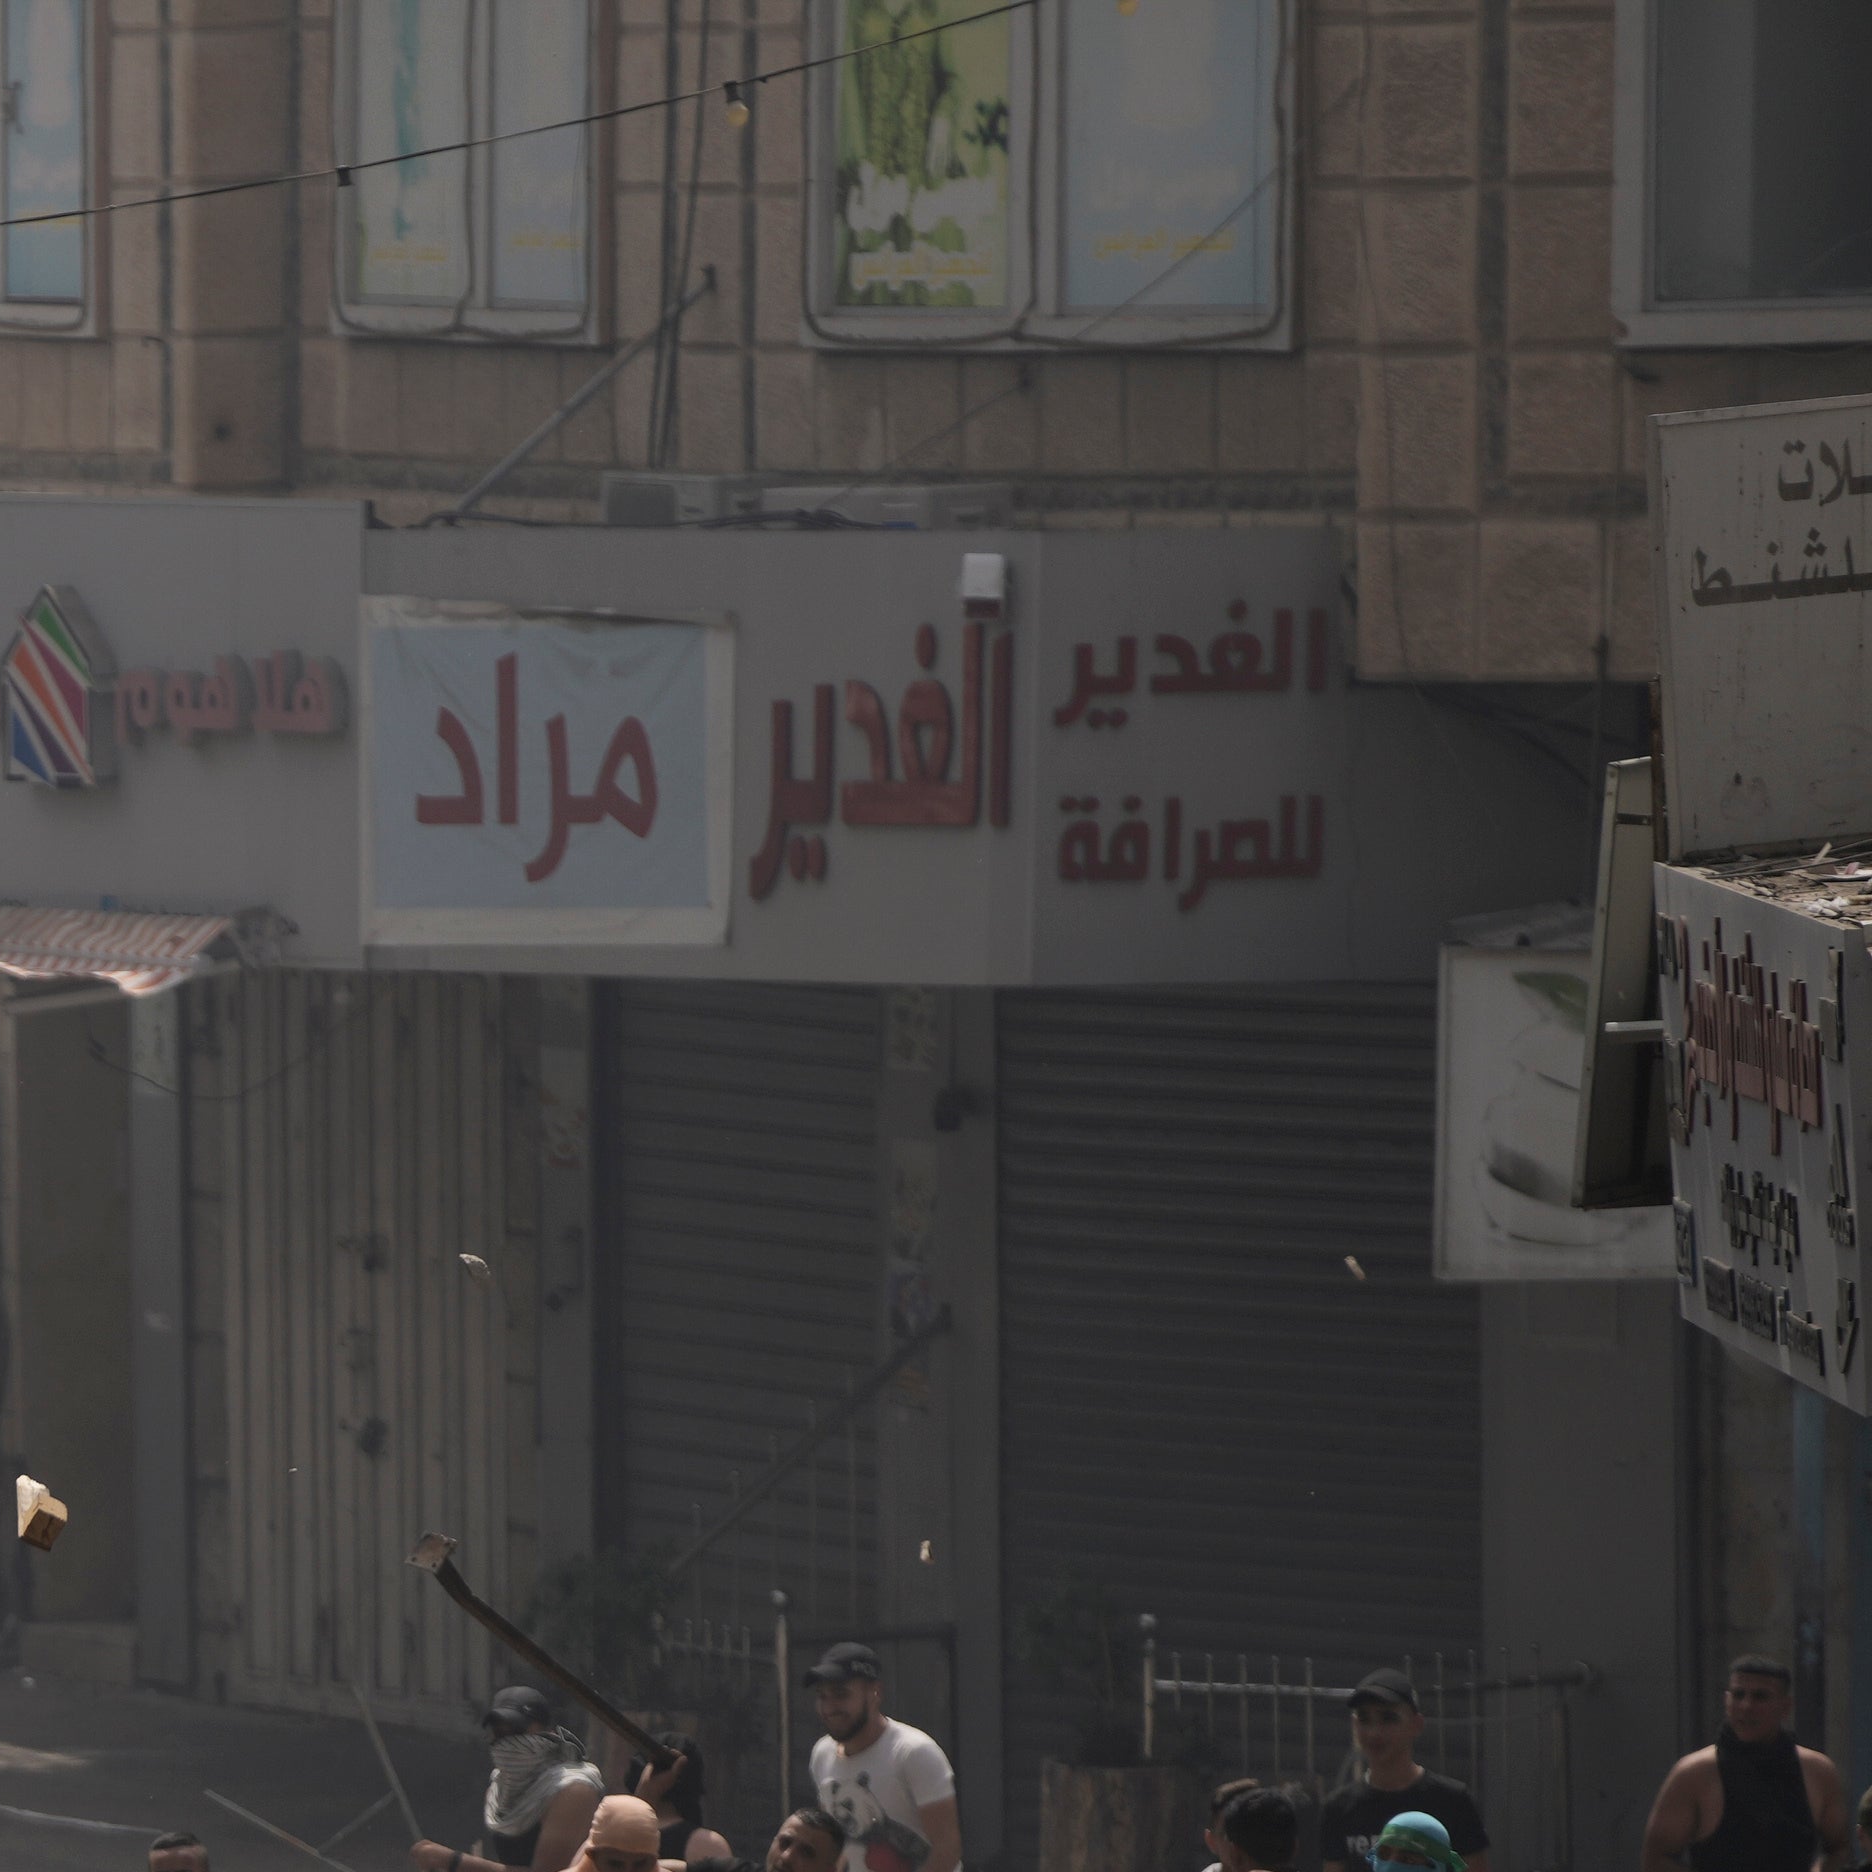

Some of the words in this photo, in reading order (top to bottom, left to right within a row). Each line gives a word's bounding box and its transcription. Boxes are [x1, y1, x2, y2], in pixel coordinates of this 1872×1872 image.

[1778, 437, 1872, 507] لات
[1054, 597, 1329, 730] الغدير
[414, 650, 660, 885] مراد
[748, 606, 1014, 900] الغدير
[1056, 793, 1326, 911] للصرافة
